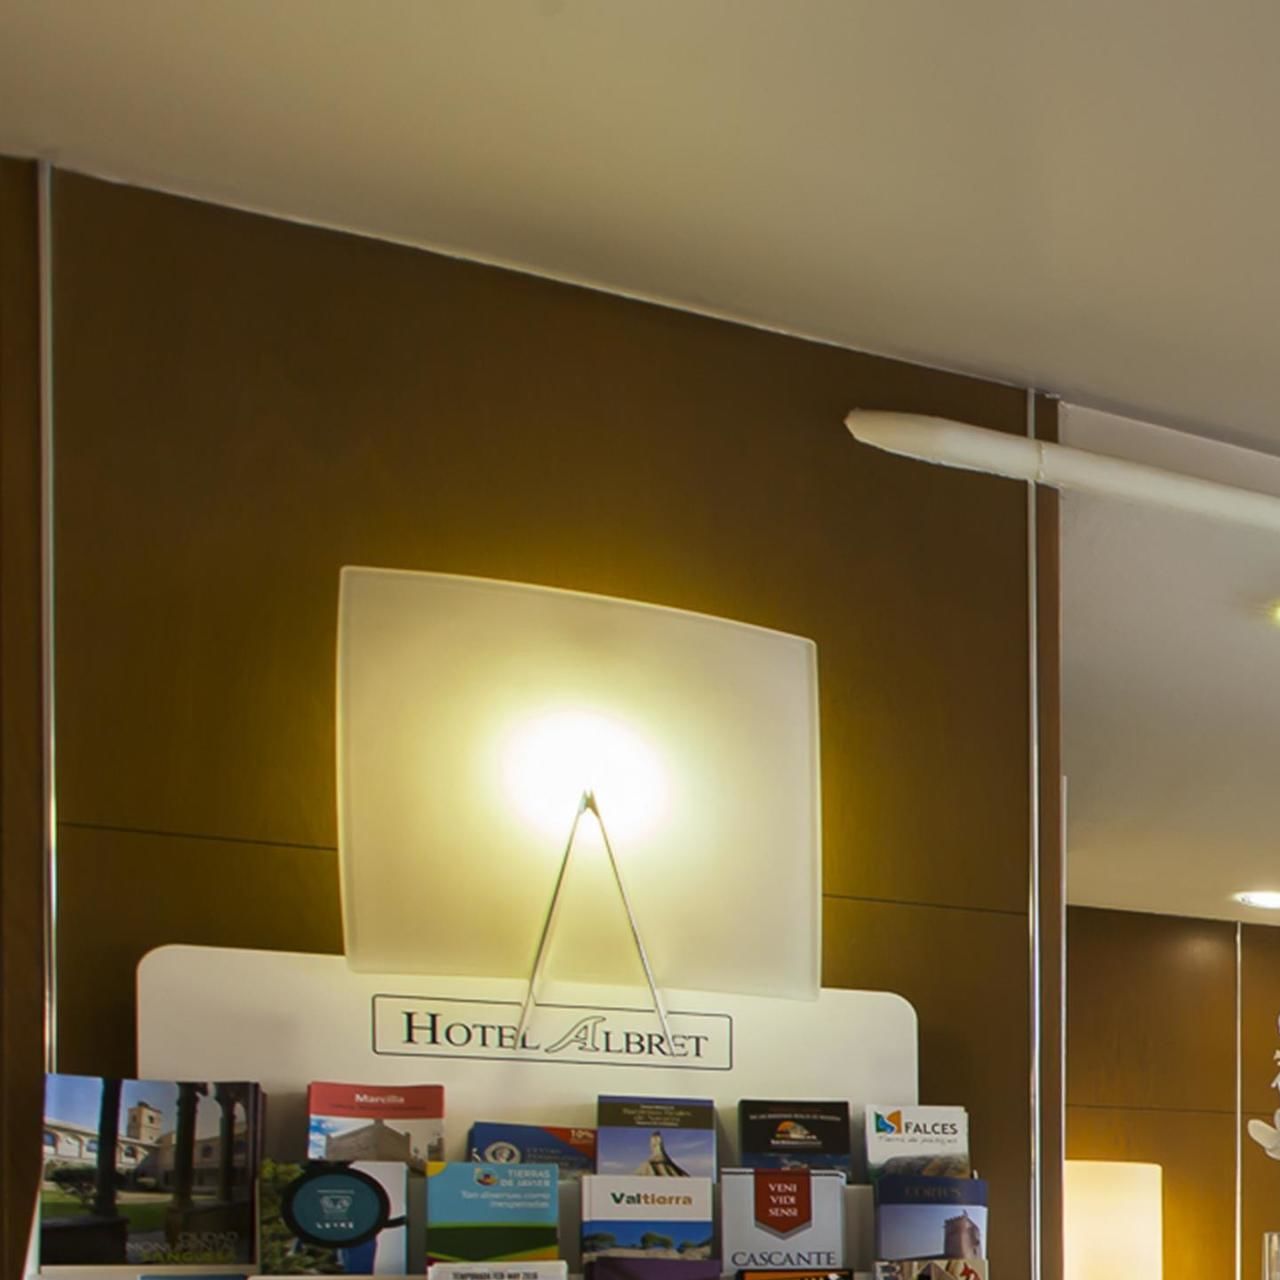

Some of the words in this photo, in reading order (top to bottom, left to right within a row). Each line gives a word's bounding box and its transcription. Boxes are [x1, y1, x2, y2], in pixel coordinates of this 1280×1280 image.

[402, 1011, 540, 1049] HOTEL
[545, 1016, 708, 1057] ALBRET
[904, 1120, 958, 1135] FALCES
[768, 1183, 797, 1193] VENI
[611, 1192, 693, 1206] Valtierra
[770, 1195, 797, 1205] VIDI
[768, 1206, 798, 1217] SENSI
[731, 1251, 837, 1267] CASCANTE
